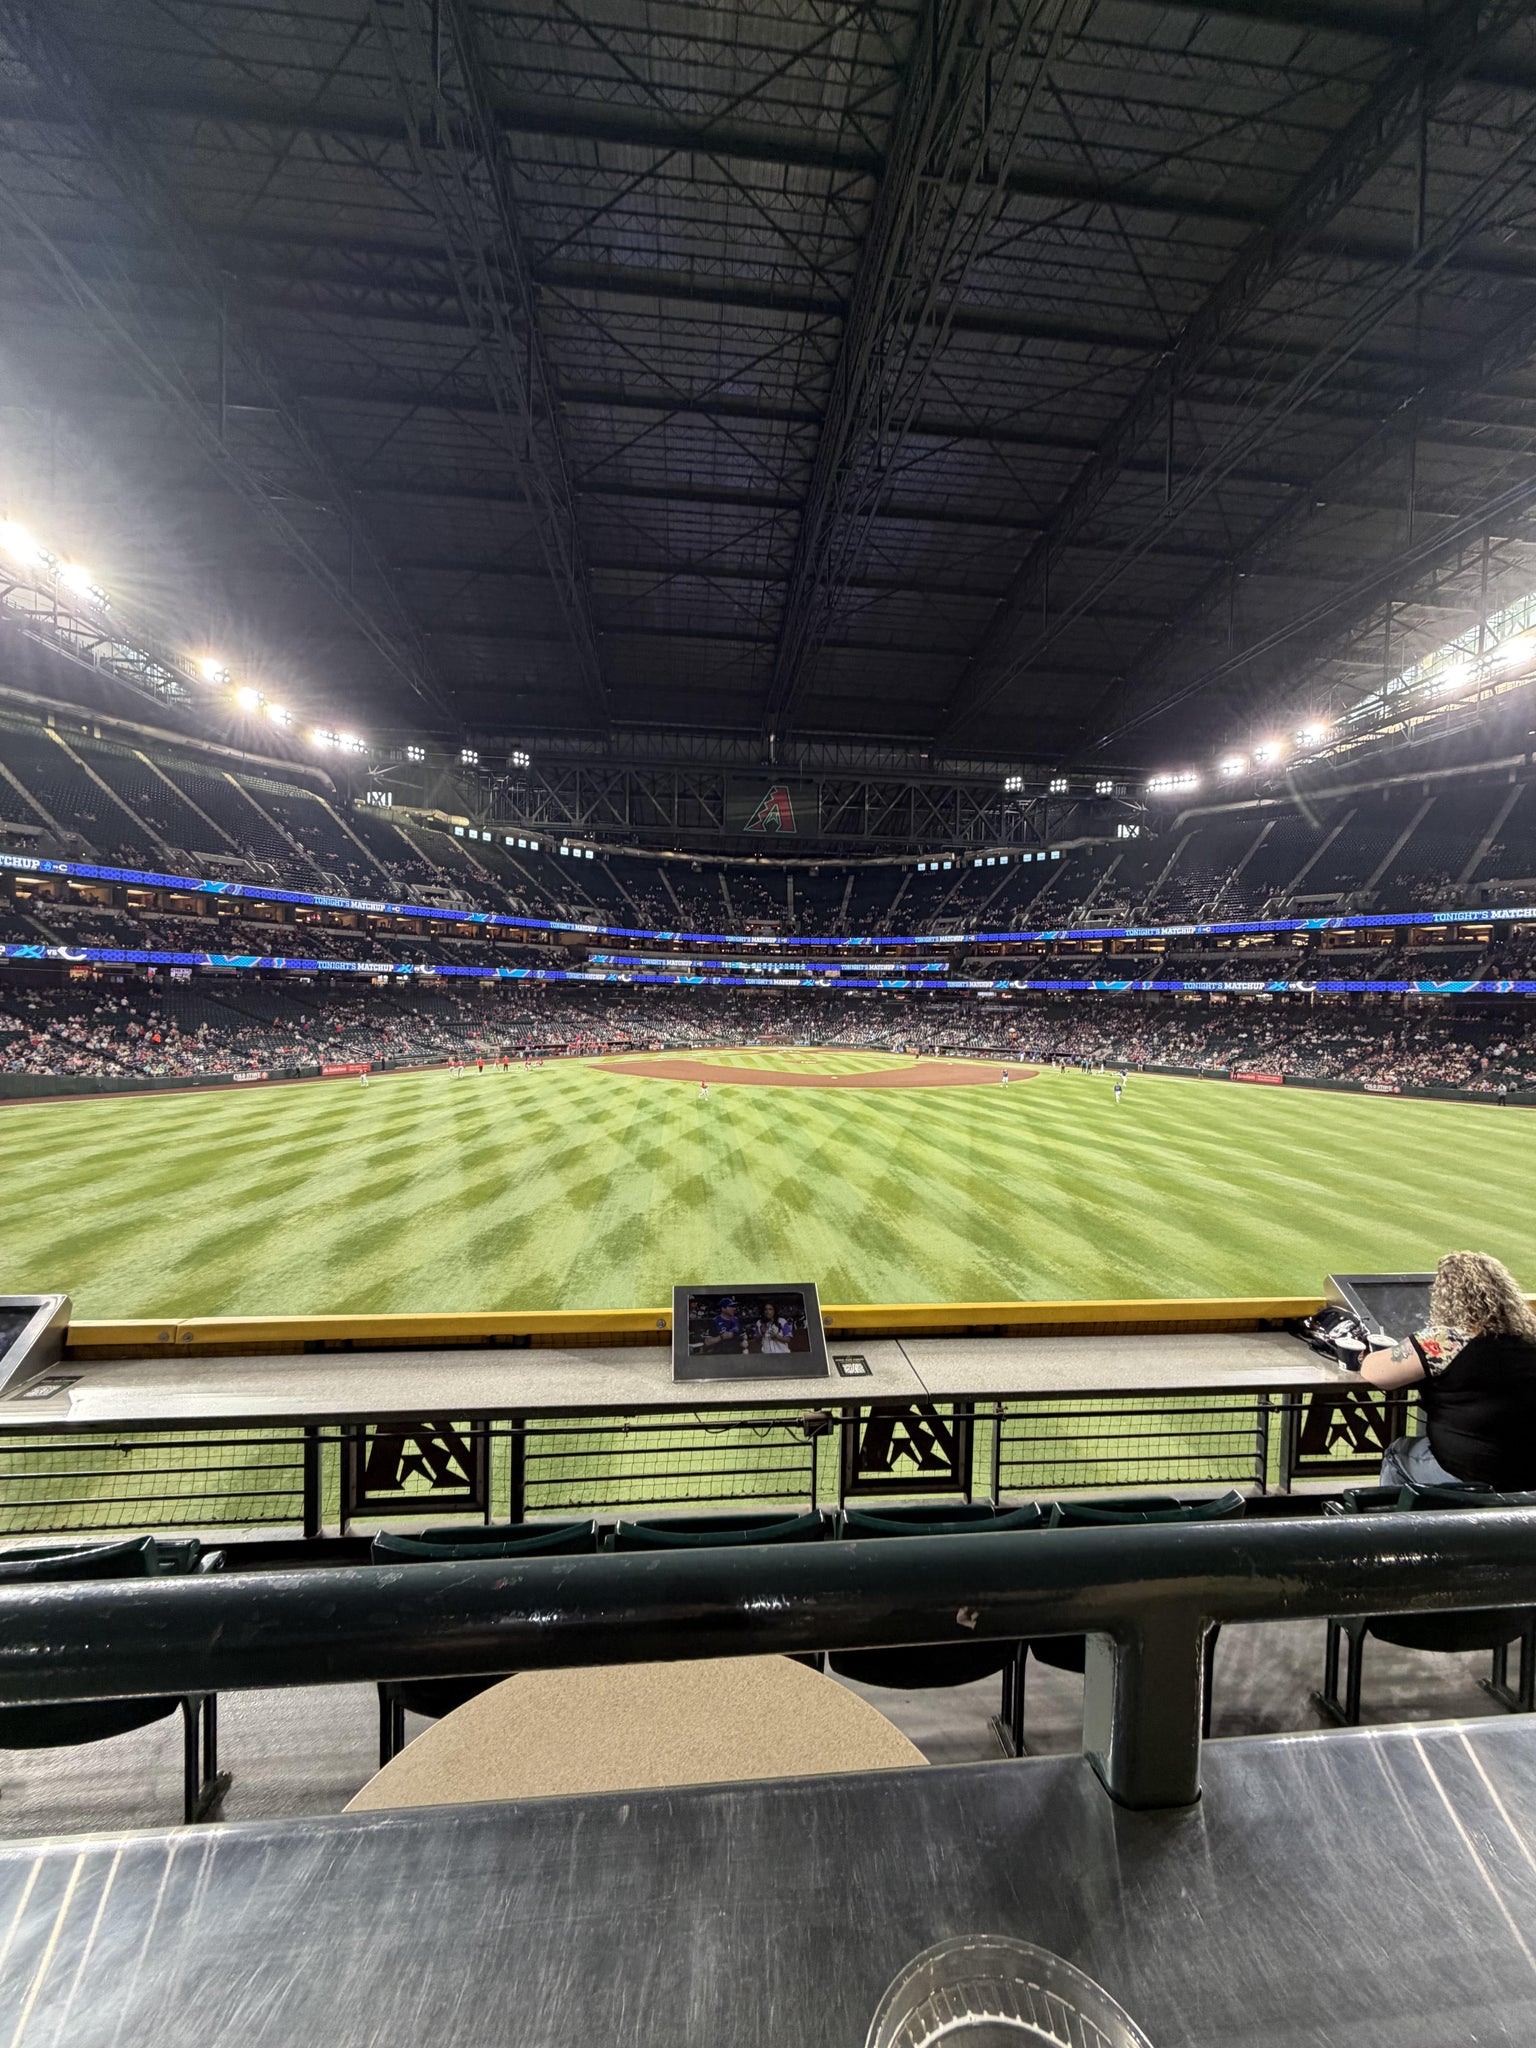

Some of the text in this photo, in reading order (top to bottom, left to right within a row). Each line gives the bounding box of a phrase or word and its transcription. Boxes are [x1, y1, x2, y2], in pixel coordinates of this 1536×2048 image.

[313, 896, 350, 909] TONIGHT'S
[350, 900, 386, 912] MATCHUP
[1433, 910, 1488, 922] TONIGHT'S
[1125, 927, 1160, 937] TONIGHT'S
[1161, 926, 1196, 936] MATCHUP
[317, 961, 356, 972] TONIGHT'S
[357, 963, 394, 972] MATCHUP
[1183, 981, 1224, 990] TONIGHT'S
[1224, 981, 1265, 990] MATCHUP
